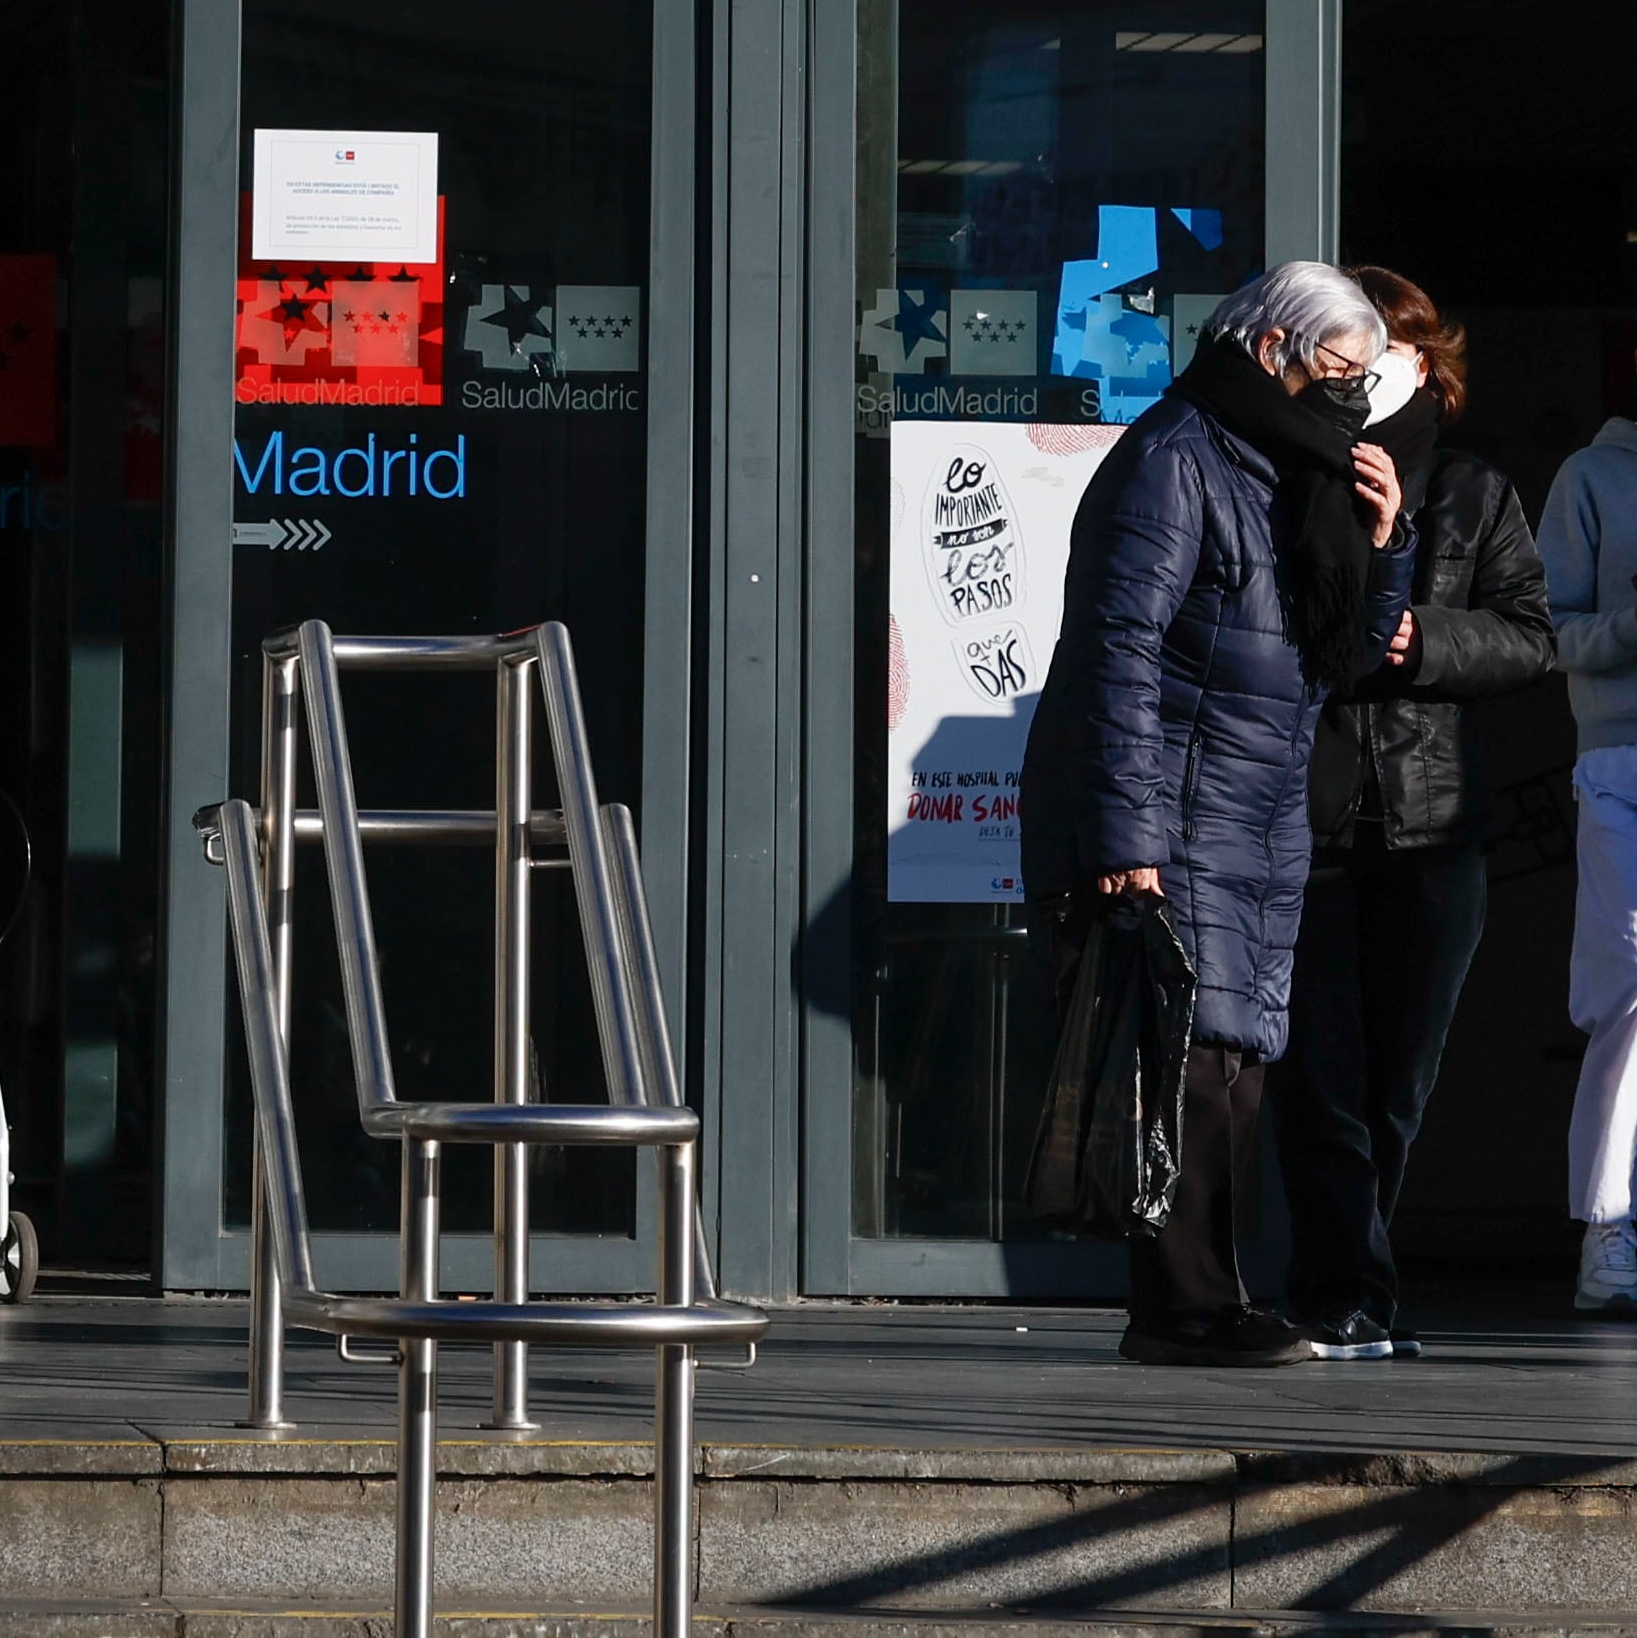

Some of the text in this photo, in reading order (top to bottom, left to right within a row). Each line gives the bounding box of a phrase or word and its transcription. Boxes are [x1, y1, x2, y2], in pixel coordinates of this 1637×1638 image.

[236, 377, 419, 407] SaludMadrid
[857, 385, 1038, 415] SaludMadrid
[234, 431, 465, 499] Madrid
[935, 483, 1002, 527] IMPORTANTE
[950, 573, 1013, 618] PASOS
[971, 638, 1026, 697] DAS
[912, 772, 927, 787] EN
[931, 771, 952, 788] ESTE
[957, 771, 999, 788] HOSPITAL
[907, 793, 963, 823] DONAR
